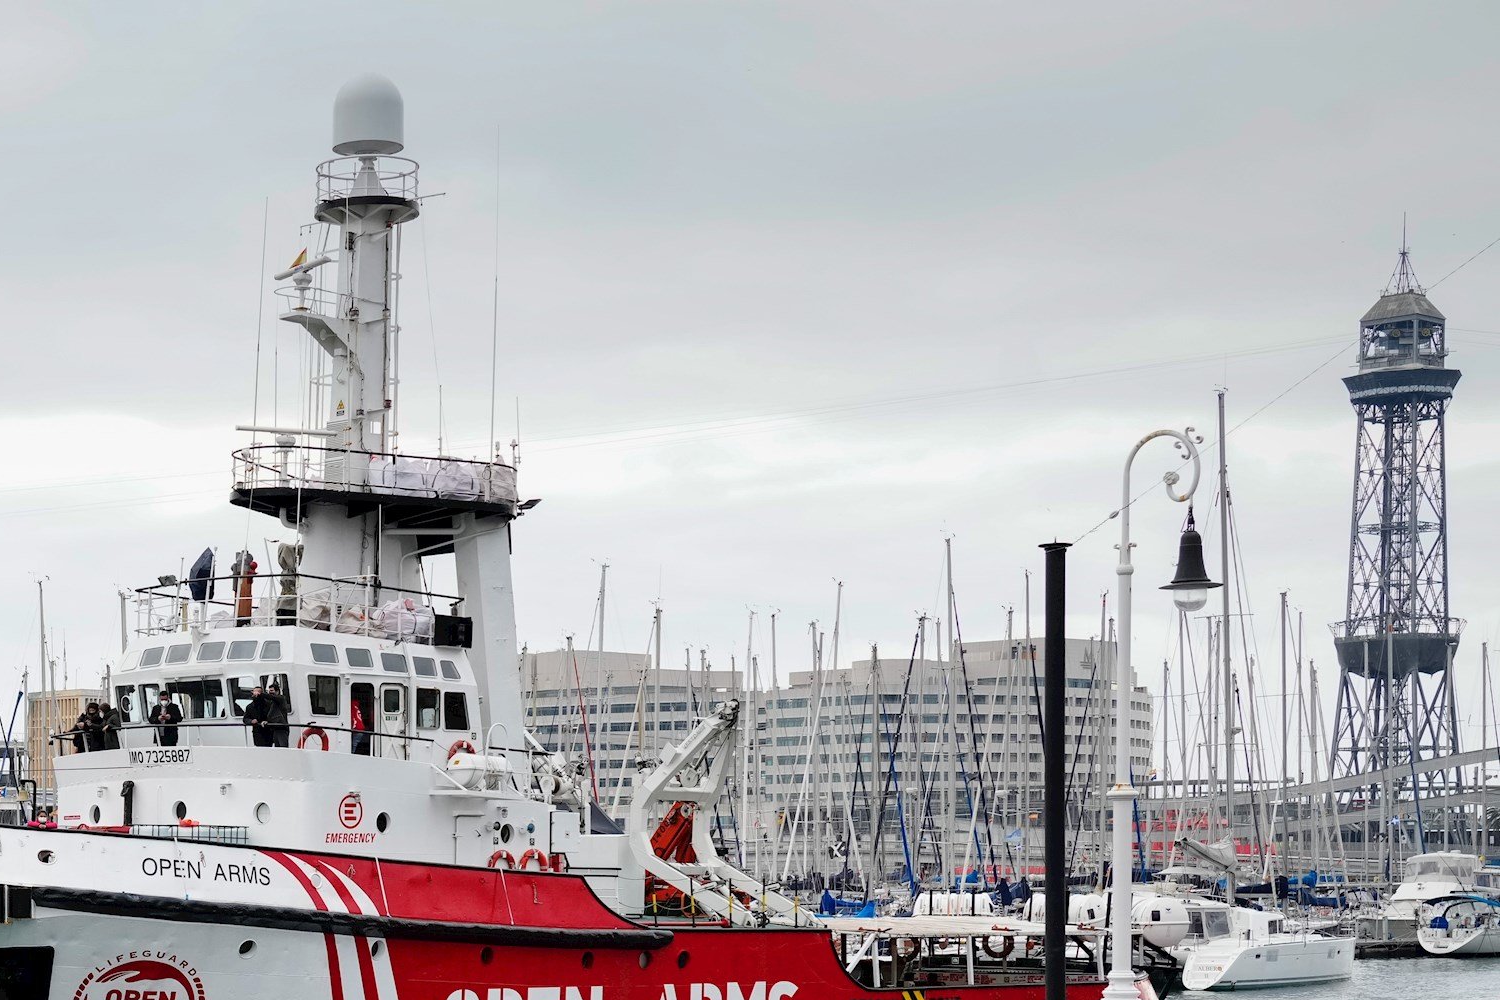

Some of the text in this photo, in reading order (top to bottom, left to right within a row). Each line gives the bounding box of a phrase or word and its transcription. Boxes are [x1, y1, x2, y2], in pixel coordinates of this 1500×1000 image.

[129, 749, 190, 764] IMO 7325887
[325, 832, 376, 844] EMERGENCY
[142, 857, 271, 886] OPEN ARMS
[95, 950, 197, 977] LIFEGUARD
